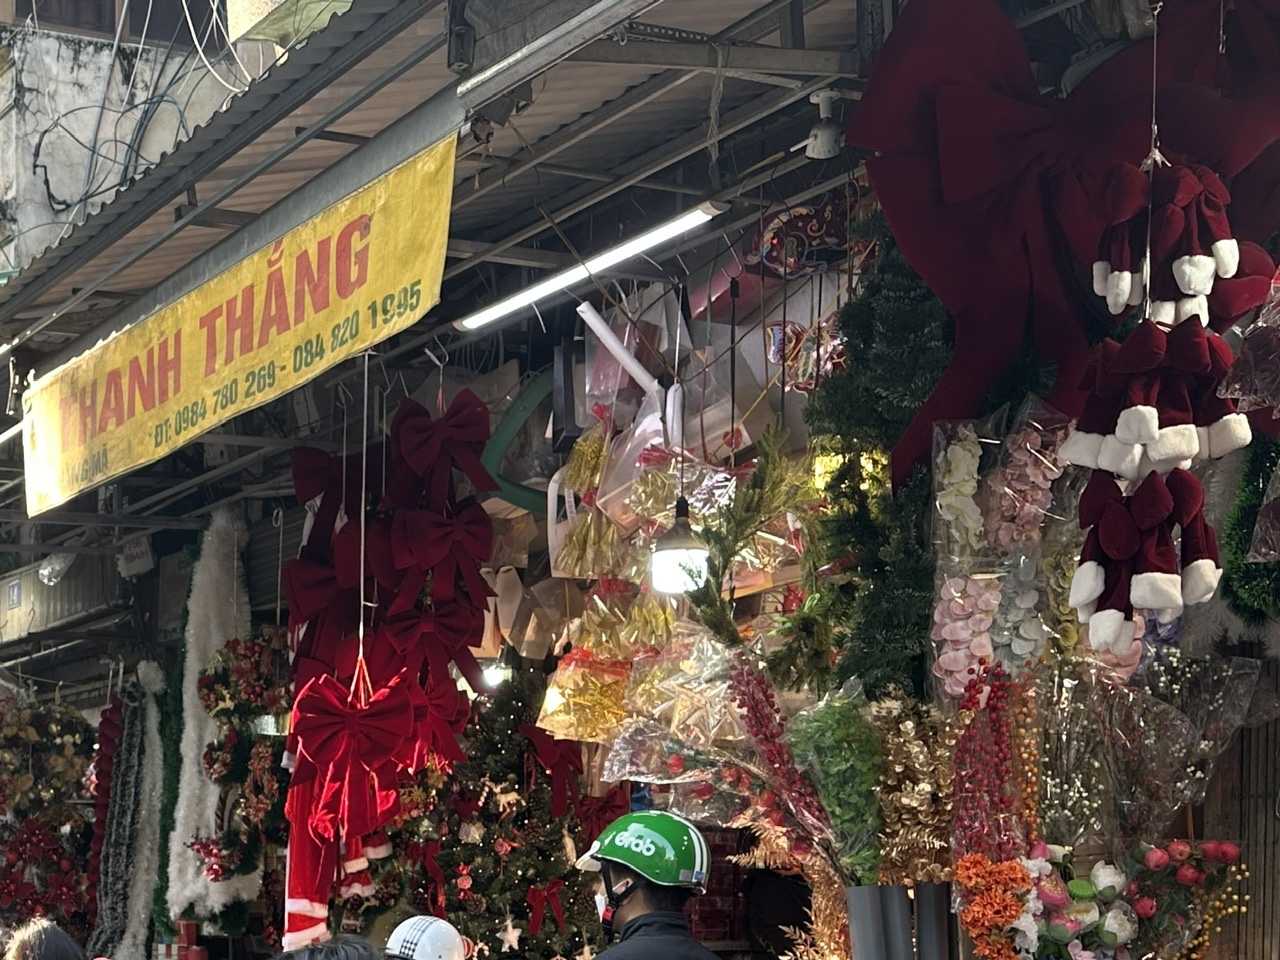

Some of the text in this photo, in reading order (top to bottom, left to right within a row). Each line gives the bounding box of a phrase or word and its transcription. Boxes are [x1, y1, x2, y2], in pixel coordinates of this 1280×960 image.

[59, 214, 372, 454] THANH THẮNG
[174, 397, 207, 436] 0984
[212, 378, 238, 415] 780
[244, 360, 276, 399] 269
[293, 332, 325, 373] 084
[331, 309, 360, 353] 820
